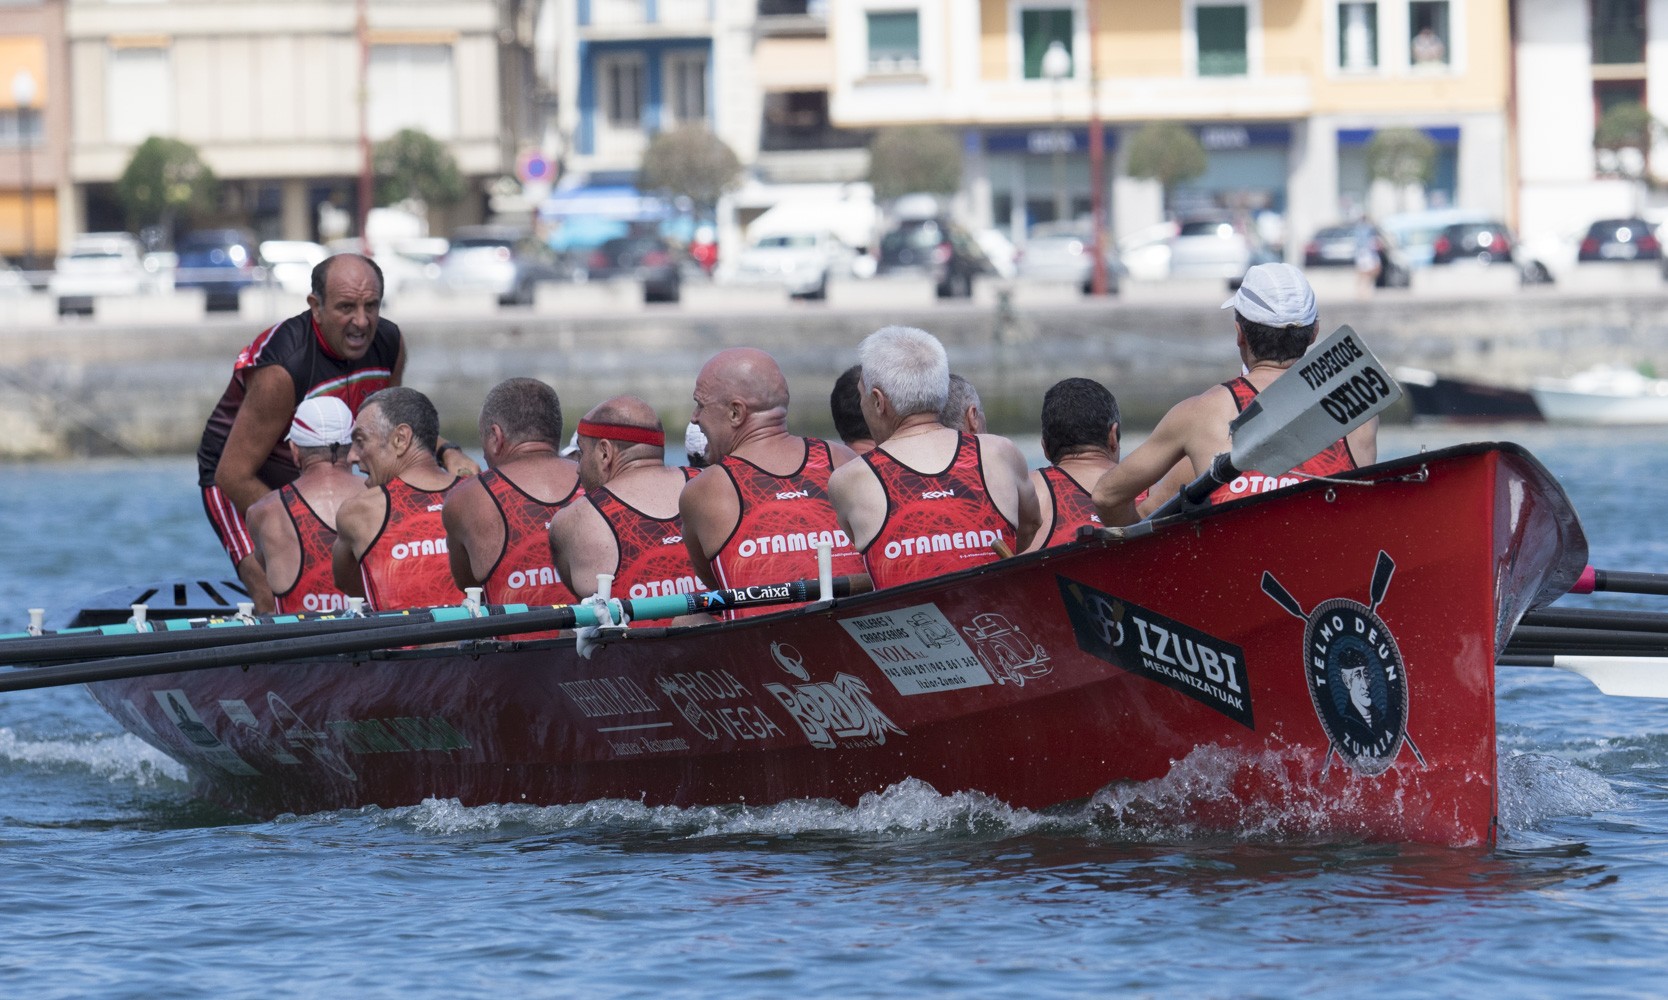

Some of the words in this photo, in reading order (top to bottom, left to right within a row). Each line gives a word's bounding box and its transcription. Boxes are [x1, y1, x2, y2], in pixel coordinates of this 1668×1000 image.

[1299, 335, 1364, 391] BODEGOIA
[1320, 366, 1390, 425] GOIKO
[1229, 476, 1309, 494] OTAM
[738, 530, 854, 558] OTAMEND
[884, 529, 1003, 559] OTAMENDI
[852, 615, 888, 631] TALLERES
[886, 615, 895, 626] Y
[871, 645, 917, 664] NOIA
[1132, 616, 1242, 694] IZUBI
[1314, 615, 1344, 687] TELMO
[1355, 617, 1397, 682] DEUN
[884, 667, 901, 679] 943
[961, 656, 979, 668] 363
[675, 669, 753, 701] RIOJA
[1142, 657, 1244, 711] MEKANIZATUAK
[706, 705, 786, 740] VEGA
[1343, 730, 1394, 757] ZUMAIA
